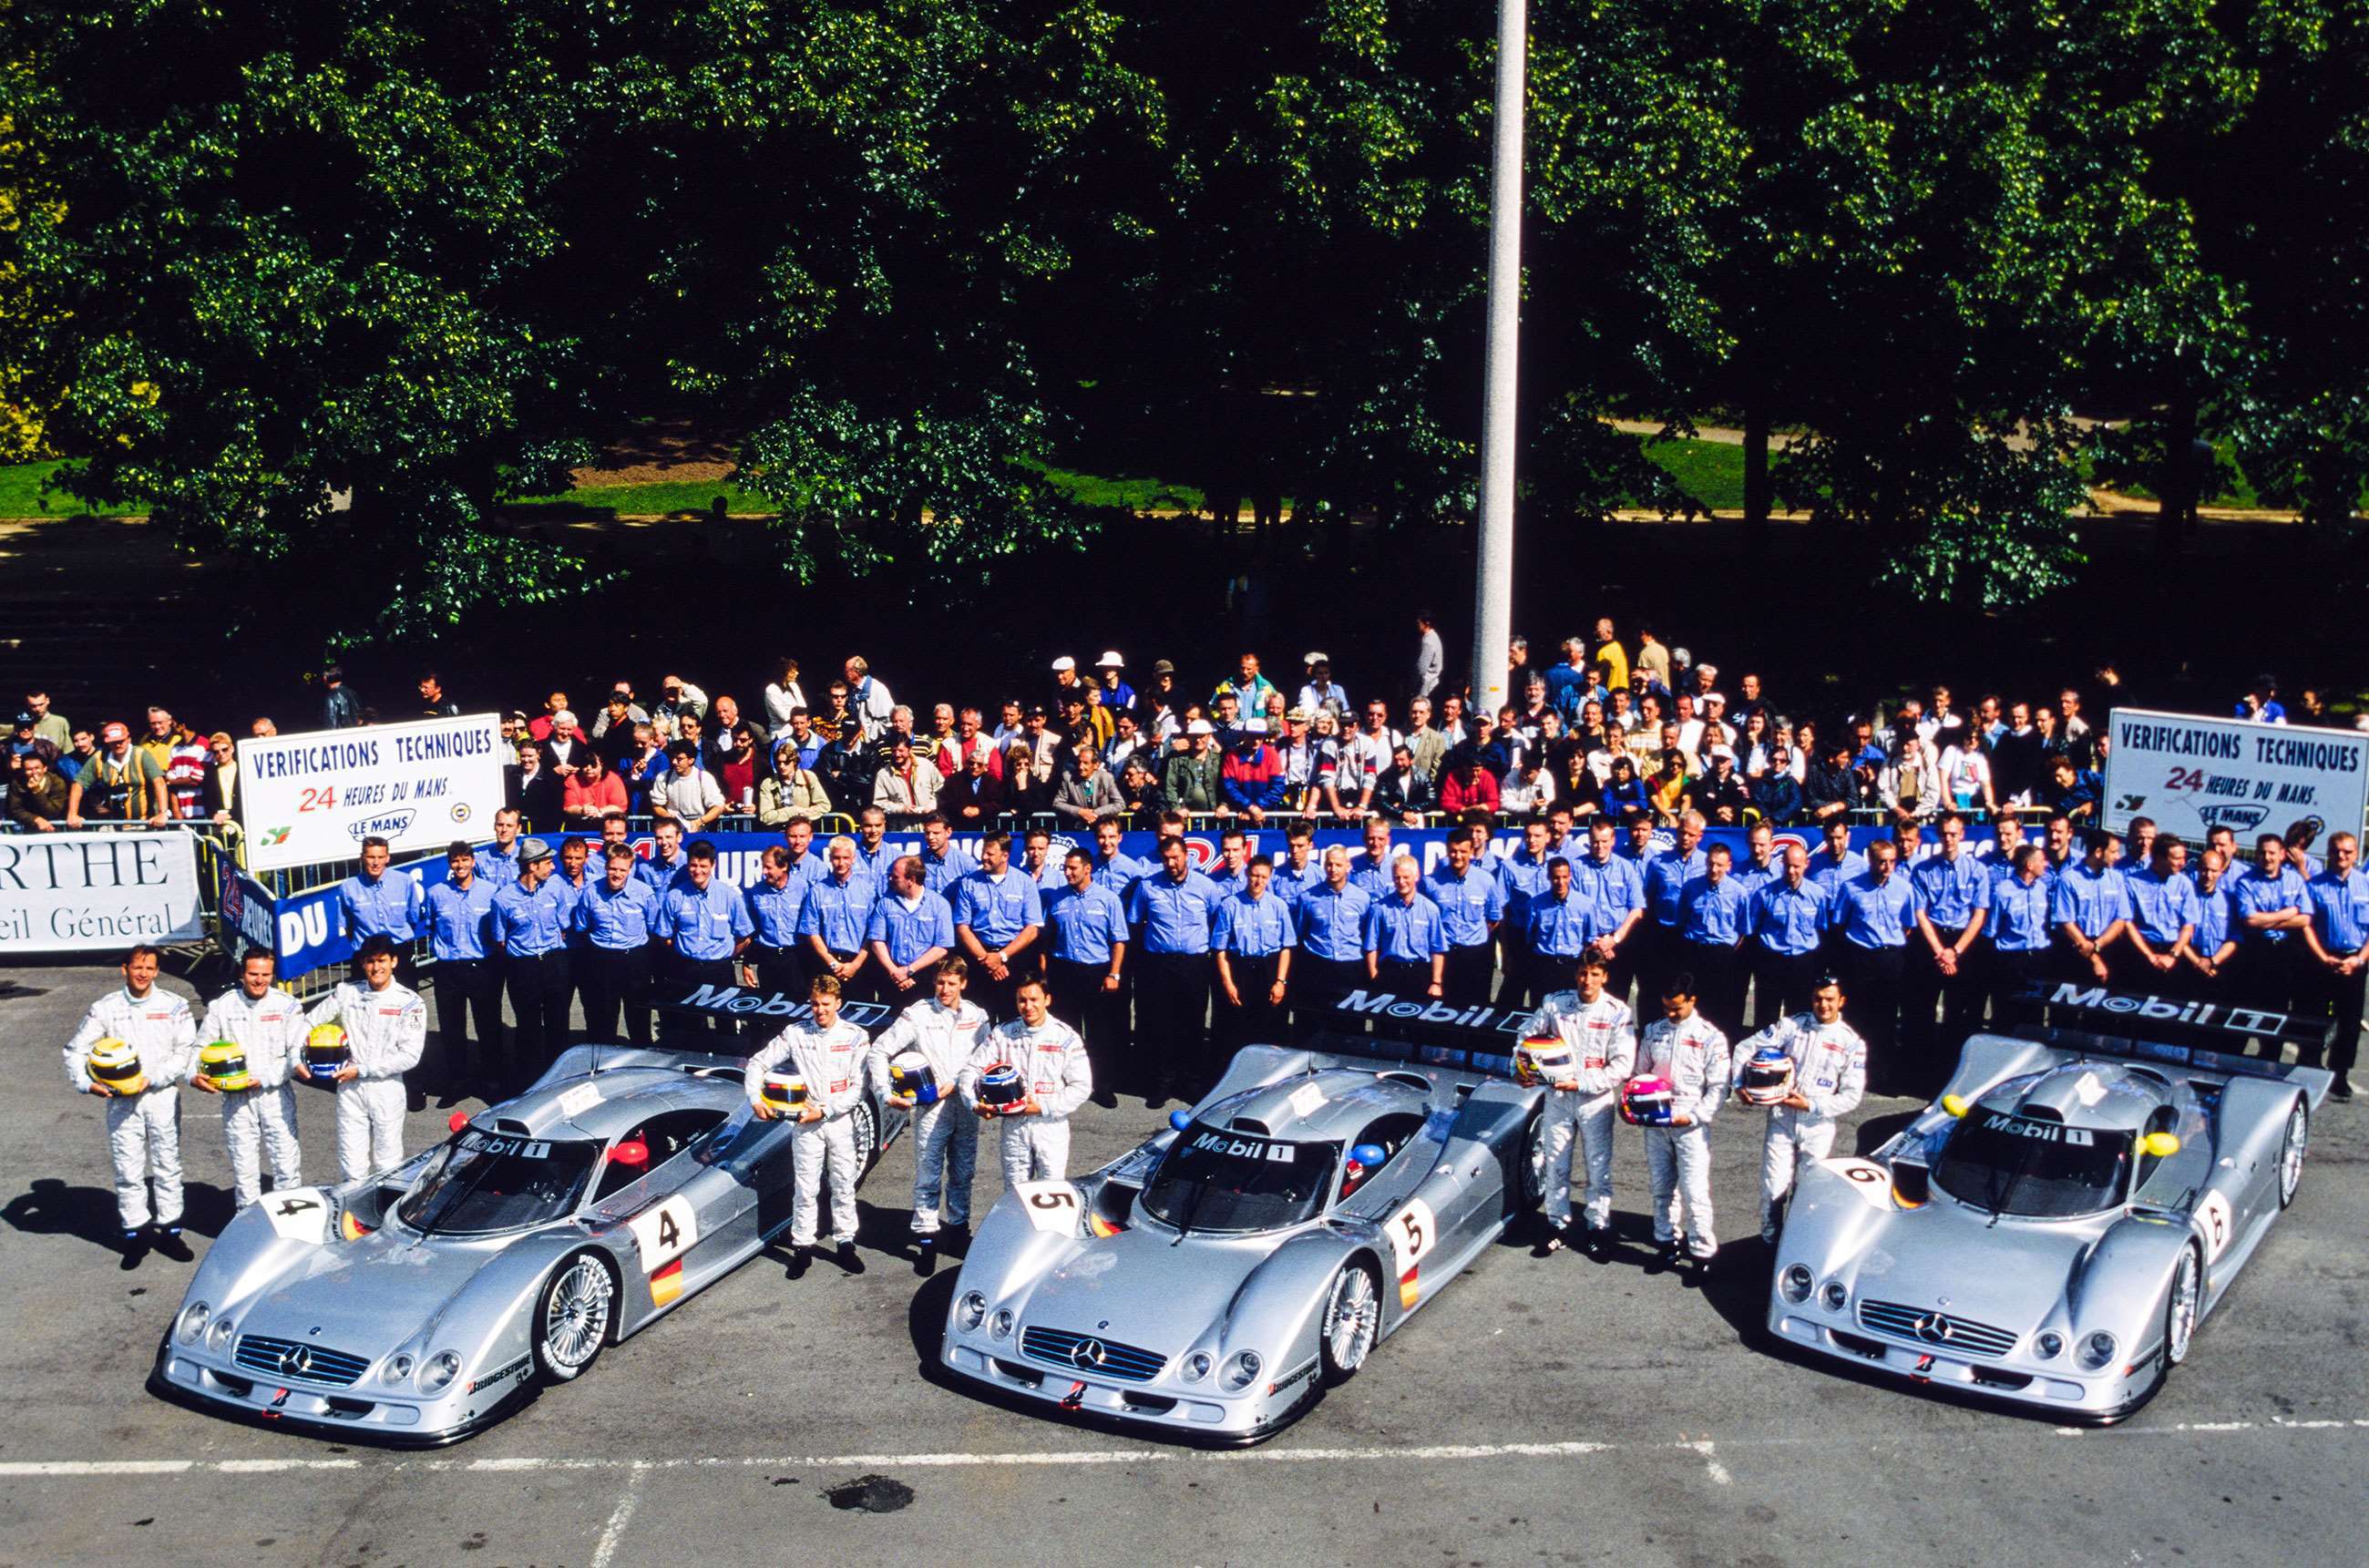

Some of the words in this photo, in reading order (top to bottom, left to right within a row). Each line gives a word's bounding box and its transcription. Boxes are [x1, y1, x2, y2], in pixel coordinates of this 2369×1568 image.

[254, 740, 379, 779] VERIFICATIONS
[395, 729, 492, 764] TECHNIQUES
[2121, 723, 2241, 760] VERIFICATIONS
[2256, 736, 2359, 774] TECHNIQUES
[299, 785, 338, 813] 24
[344, 784, 386, 807] HEURES
[392, 781, 409, 802] DU
[2164, 765, 2204, 793] 24
[2205, 775, 2251, 799] HEURES
[2253, 781, 2274, 801] DU
[353, 822, 366, 835] LE
[370, 816, 409, 833] MANS
[2203, 807, 2218, 821] LE
[2220, 809, 2261, 825] MANS
[51, 903, 176, 939] Général
[279, 900, 328, 958] DU
[1337, 989, 1495, 1028] Mobil
[2049, 982, 2216, 1025] Mobil
[457, 1131, 522, 1156] Mobil
[1192, 1132, 1264, 1159] Mobil
[1983, 1114, 2059, 1142] Mobil
[1844, 1167, 1886, 1183] 6
[276, 1198, 321, 1217] 4
[1031, 1192, 1075, 1210] 5
[659, 1209, 681, 1250] 4
[1401, 1212, 1422, 1256] 5
[2209, 1206, 2223, 1247] 6
[579, 1254, 614, 1297] POTENZA
[466, 1354, 531, 1397] BRIDGESTONE
